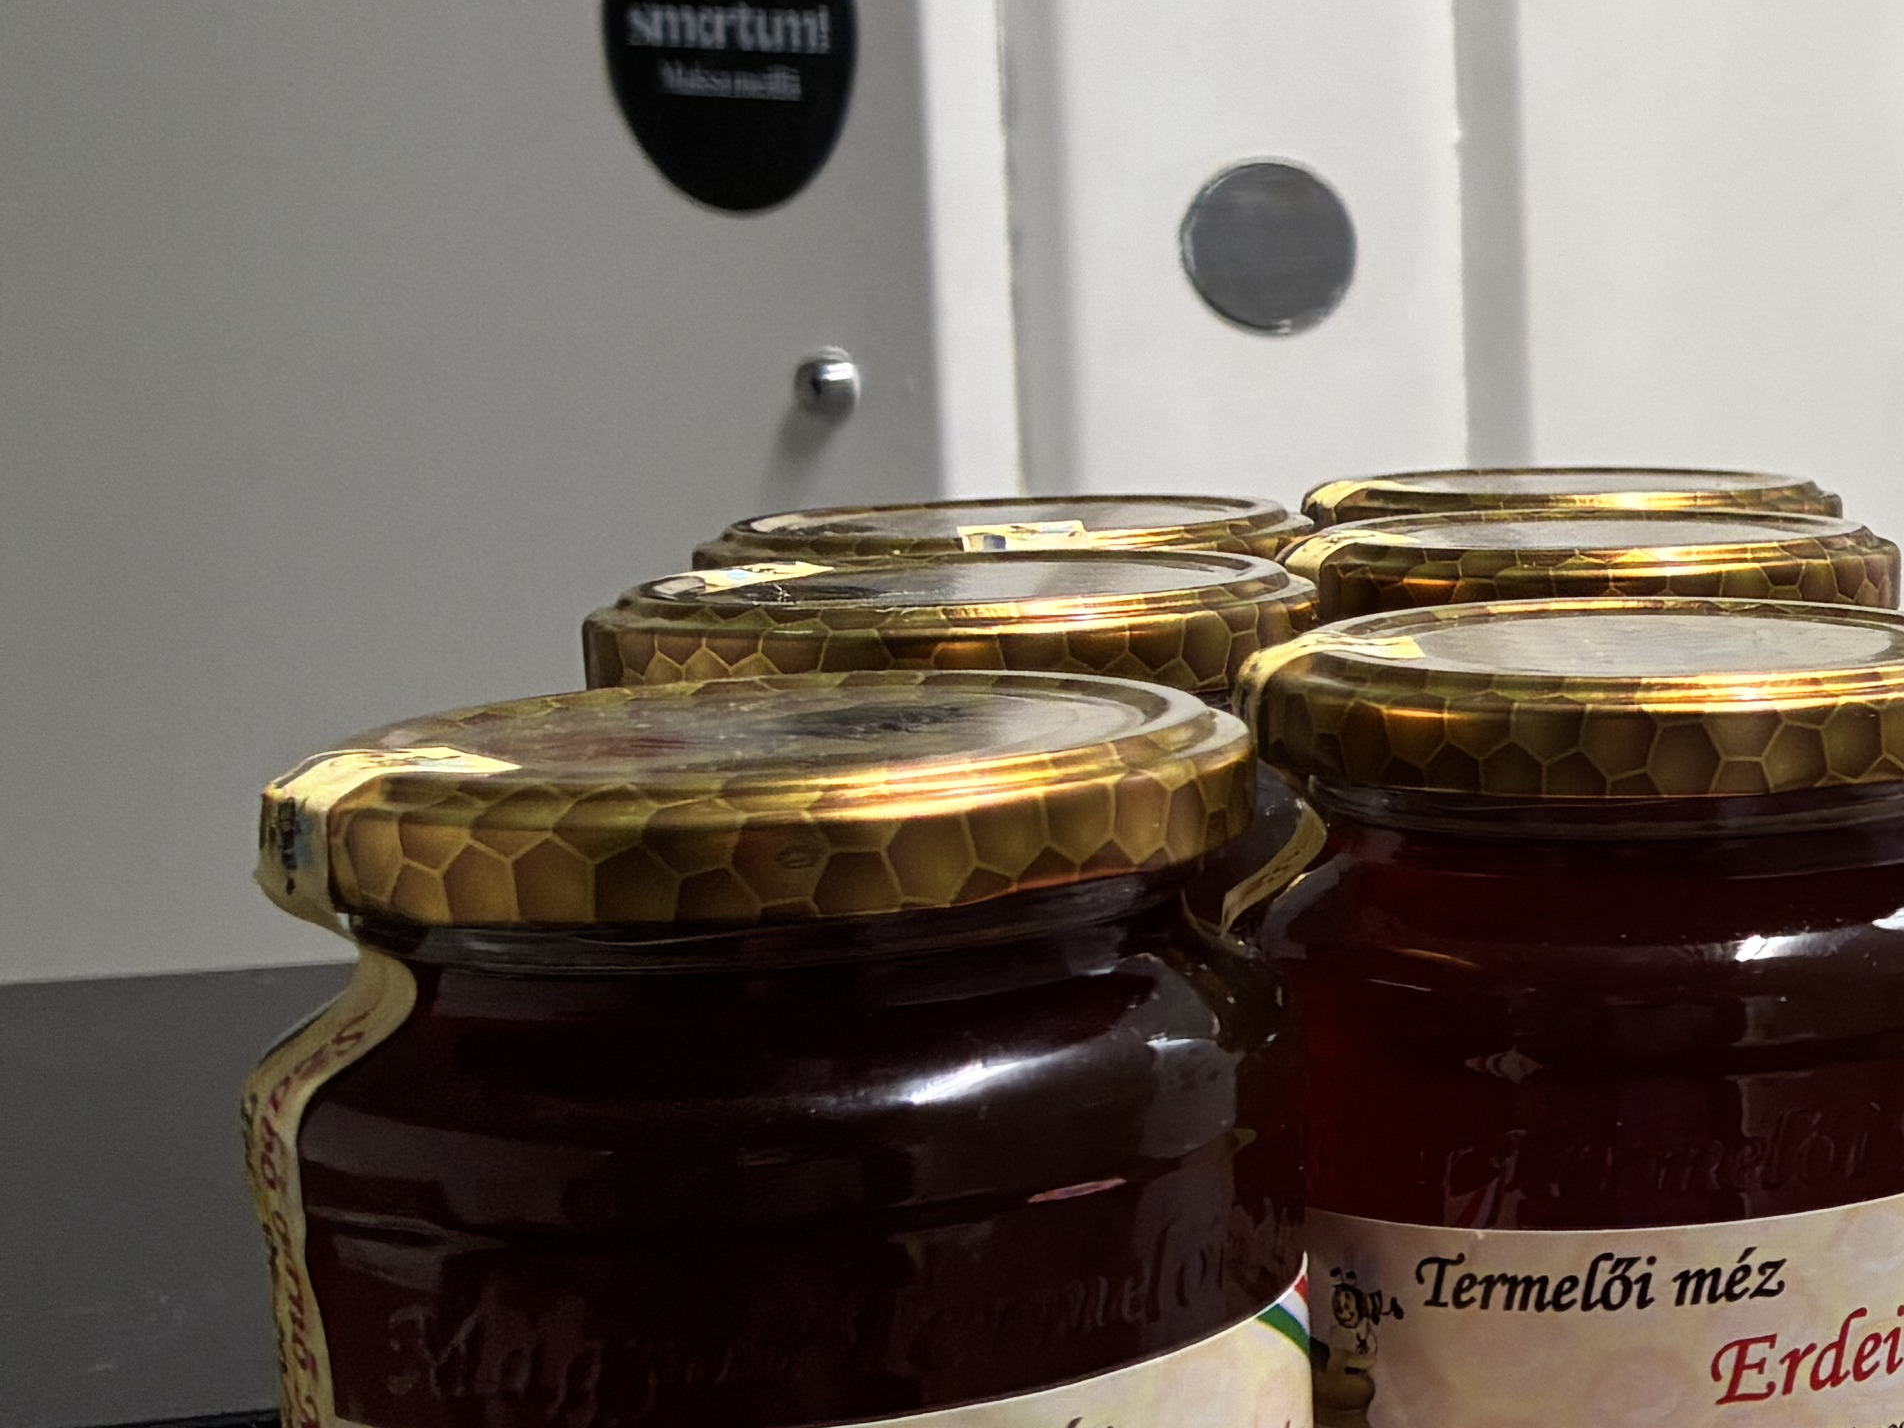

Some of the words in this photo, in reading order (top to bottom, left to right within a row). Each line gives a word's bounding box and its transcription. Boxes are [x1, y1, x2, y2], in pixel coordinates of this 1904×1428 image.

[627, 2, 830, 54] smartum!
[1415, 1252, 1657, 1313] Termelői
[1672, 1246, 1788, 1308] méz
